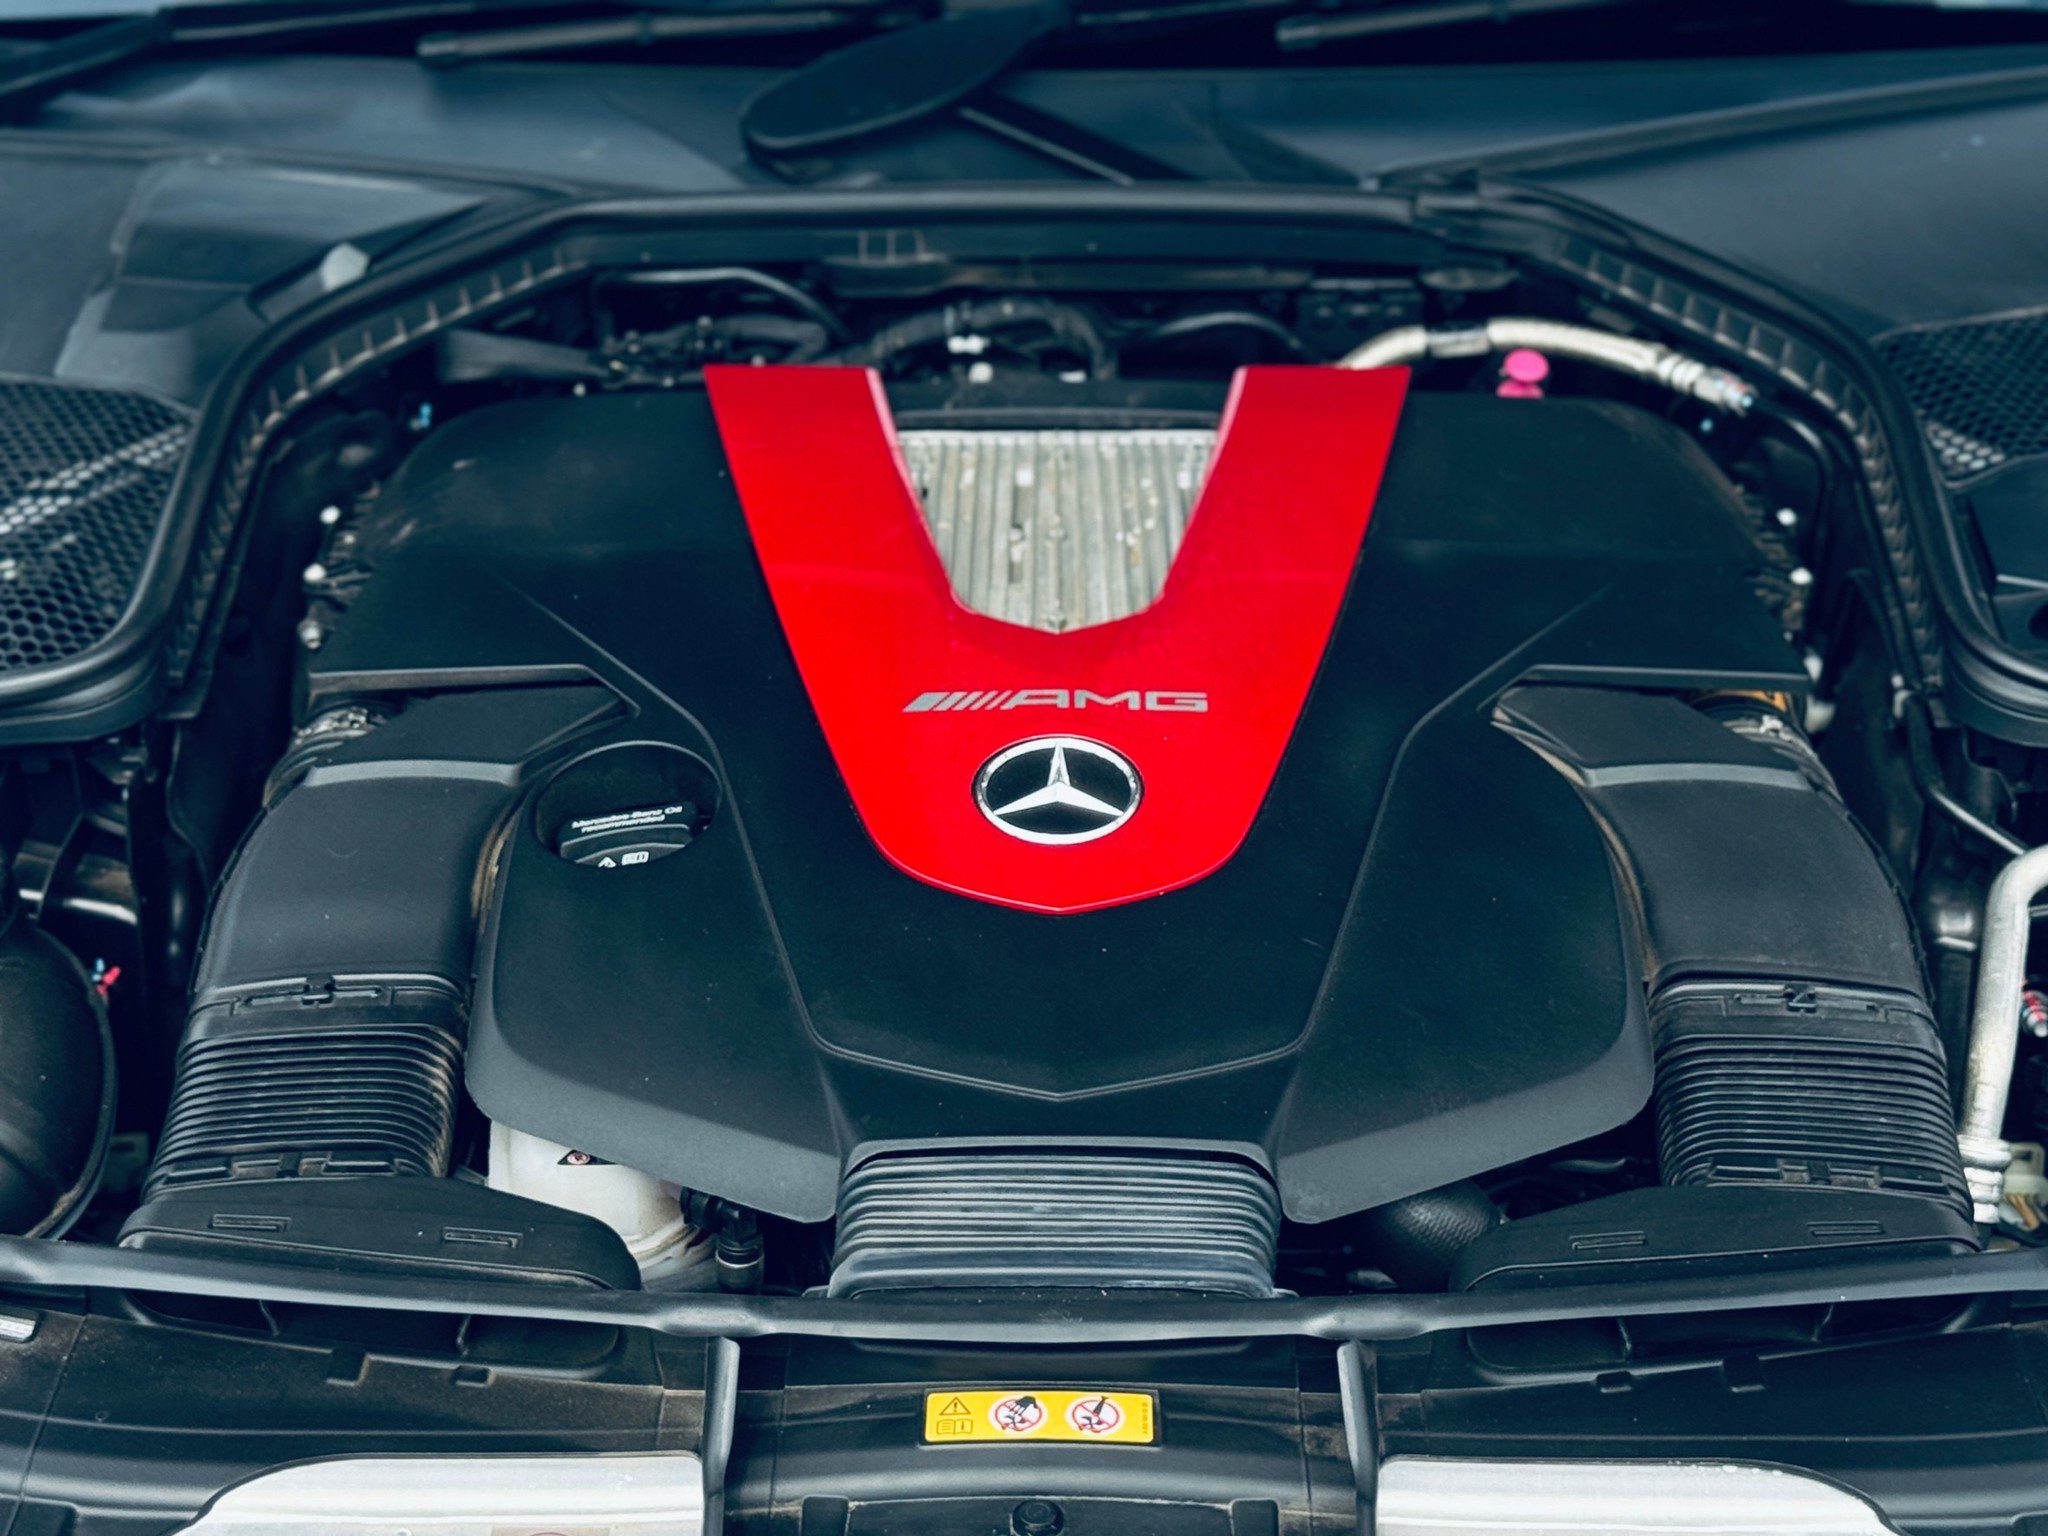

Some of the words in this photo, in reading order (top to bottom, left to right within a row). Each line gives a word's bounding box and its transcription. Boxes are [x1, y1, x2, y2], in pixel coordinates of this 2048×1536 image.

[1000, 689, 1209, 712] AMG
[571, 809, 662, 829] Mercedes-Benz
[664, 805, 683, 815] Oil
